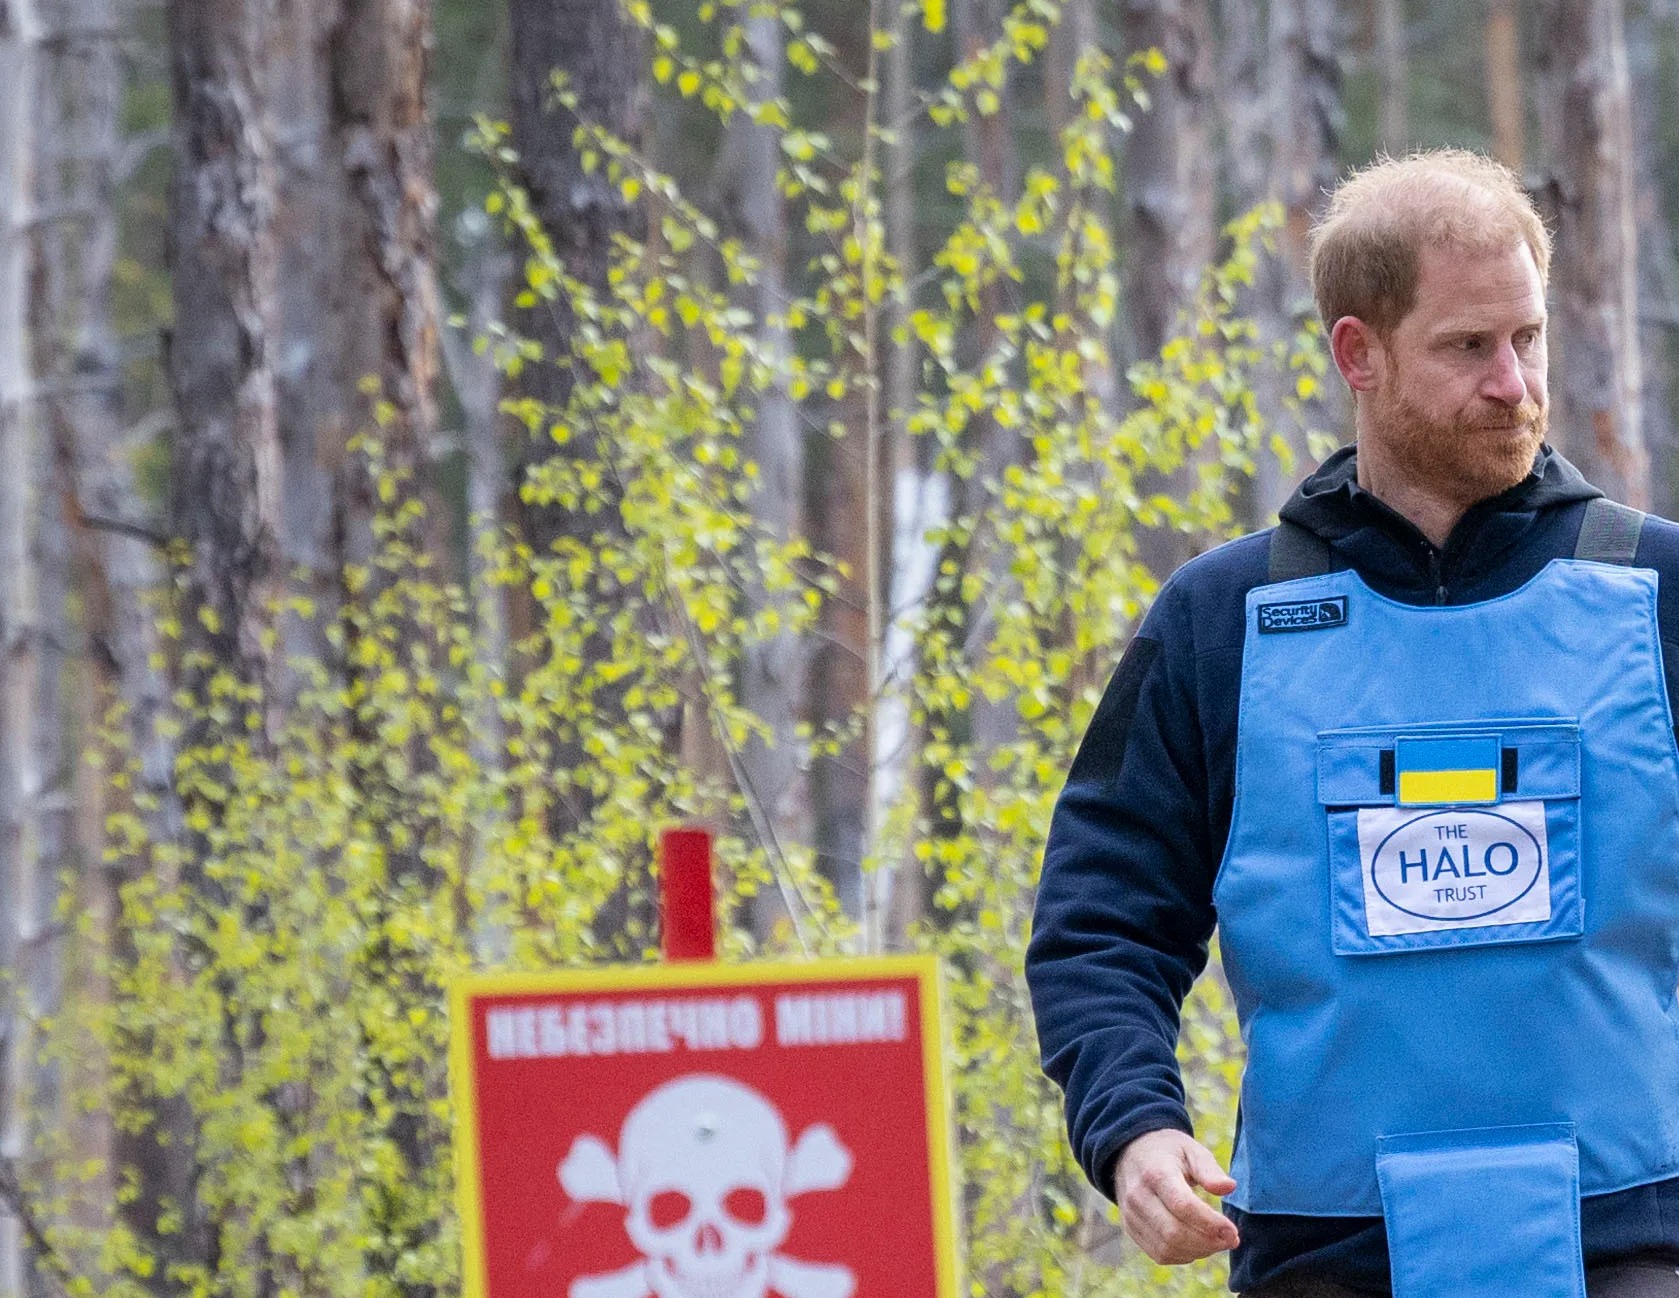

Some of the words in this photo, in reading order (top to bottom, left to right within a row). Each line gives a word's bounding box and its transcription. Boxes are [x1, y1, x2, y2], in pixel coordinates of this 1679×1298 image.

[1262, 604, 1318, 618] Security
[1262, 615, 1318, 628] Devices
[1434, 824, 1468, 841] THE
[1400, 842, 1519, 884] HALO
[1433, 885, 1487, 903] TRUST
